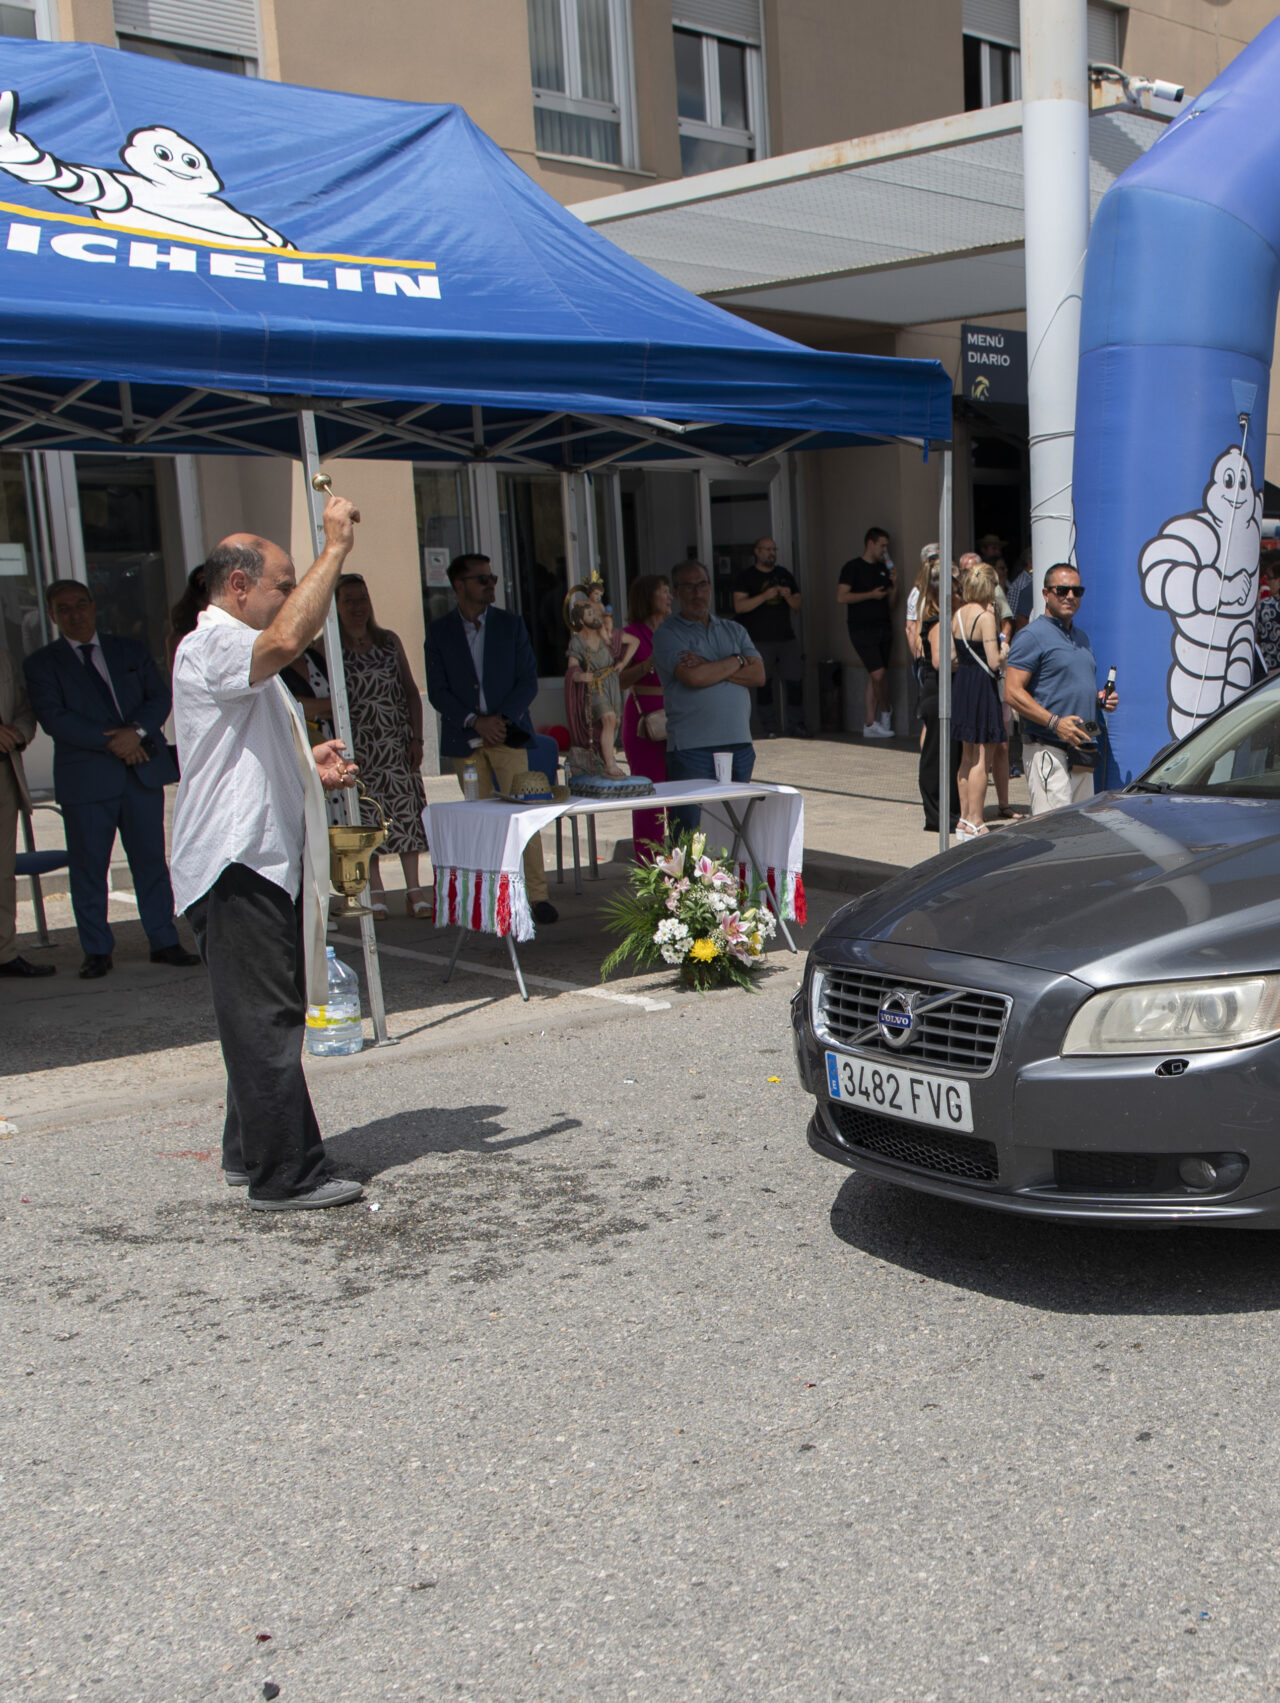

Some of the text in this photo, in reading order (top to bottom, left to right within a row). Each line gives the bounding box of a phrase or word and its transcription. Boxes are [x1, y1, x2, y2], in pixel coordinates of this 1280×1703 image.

[6, 222, 442, 299] ICHELIN
[967, 332, 1005, 348] MENÚ
[967, 351, 1011, 367] DIARIO
[880, 1012, 909, 1025] VOLVO
[843, 1062, 903, 1111] 3482
[910, 1077, 963, 1123] FVG
